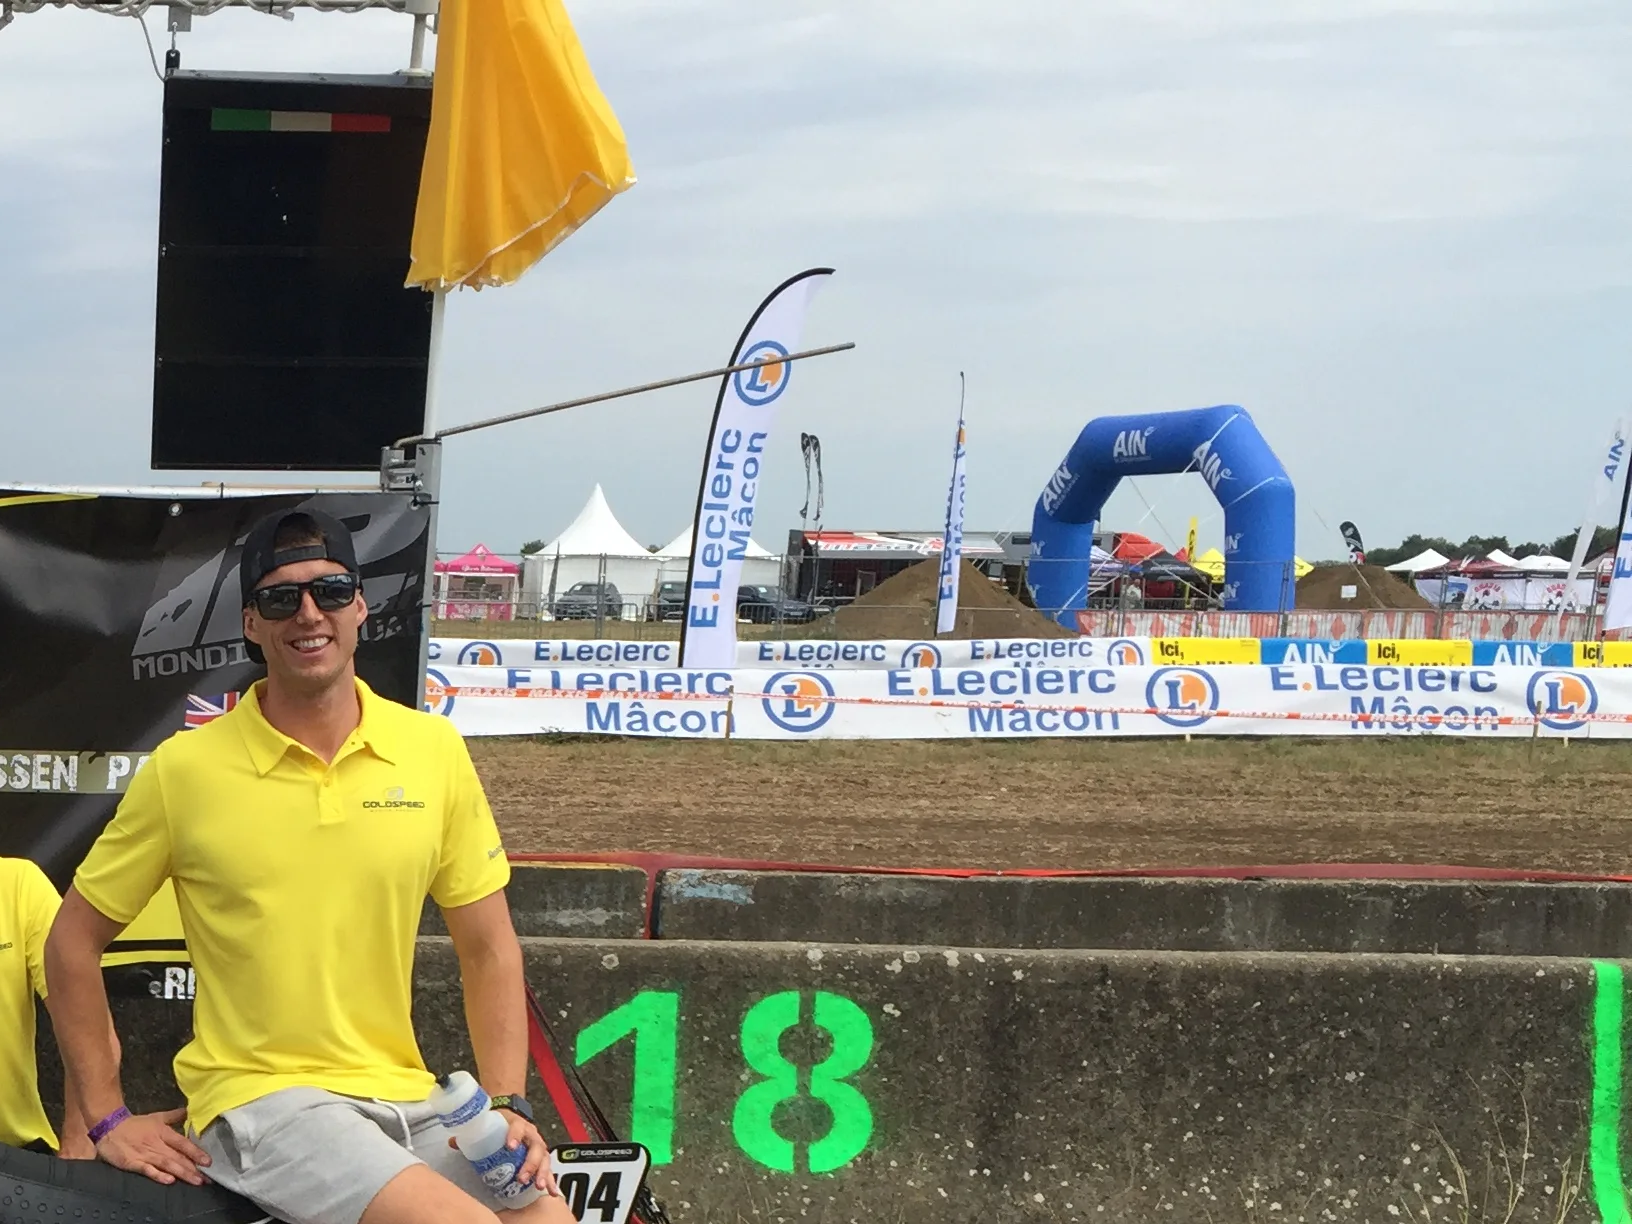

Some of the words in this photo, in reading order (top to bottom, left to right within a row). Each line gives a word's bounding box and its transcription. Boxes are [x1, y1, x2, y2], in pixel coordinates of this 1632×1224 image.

[1113, 431, 1147, 457] AIN
[1604, 438, 1625, 482] AIN
[727, 431, 768, 561] Mâcon
[689, 428, 742, 628] E.Leclerc
[132, 644, 250, 681] MONDI
[534, 641, 670, 662] E.Leclerc
[758, 641, 886, 662] E.Leclerc
[970, 640, 1093, 661] E.Leclerc
[1282, 642, 1335, 665] AIN
[1493, 644, 1542, 667] AIN
[887, 668, 1116, 697] E.Leclerc
[1270, 664, 1498, 692] E.Leclerc
[585, 701, 735, 733] Mâcon
[968, 700, 1120, 732] Mâcon
[1350, 696, 1499, 731] Mâcon
[363, 800, 426, 809] GOLDSPEED
[574, 989, 875, 1175] 18
[580, 1148, 633, 1156] GOLDSPEED
[555, 1171, 622, 1223] 04
